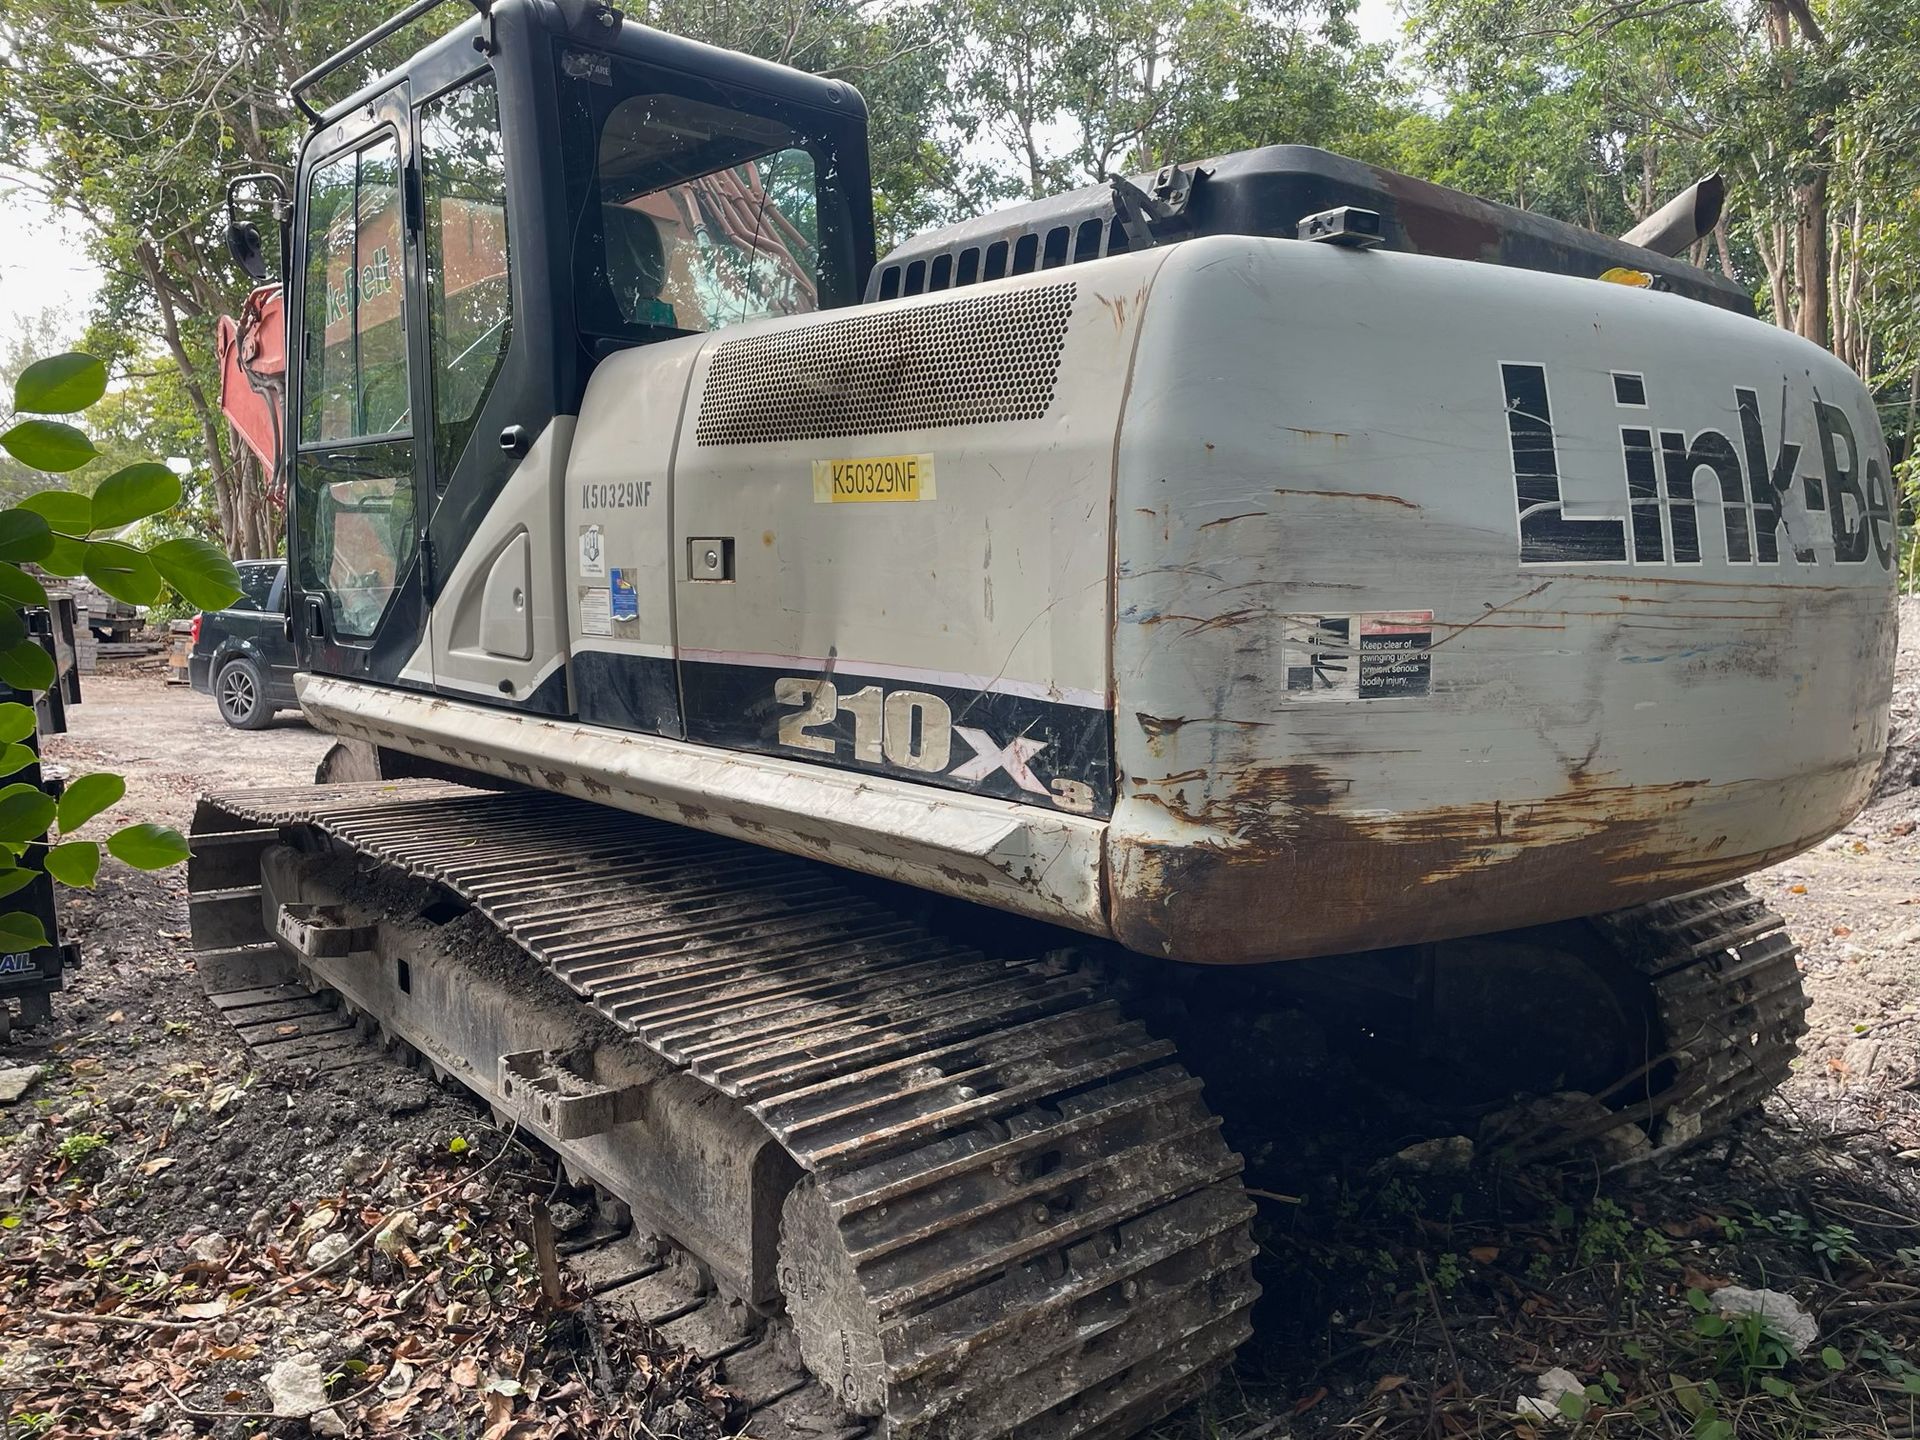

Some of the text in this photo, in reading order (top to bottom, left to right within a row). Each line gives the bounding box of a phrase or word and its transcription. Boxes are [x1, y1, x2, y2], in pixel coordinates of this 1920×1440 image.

[833, 461, 916, 494] K50329NF
[583, 481, 651, 509] K50329NF
[1362, 639, 1412, 651] Keep clear of
[1362, 653, 1395, 664] swinging
[1420, 651, 1429, 660] to
[1392, 663, 1419, 673] serious
[1361, 675, 1409, 687] bodily injury.
